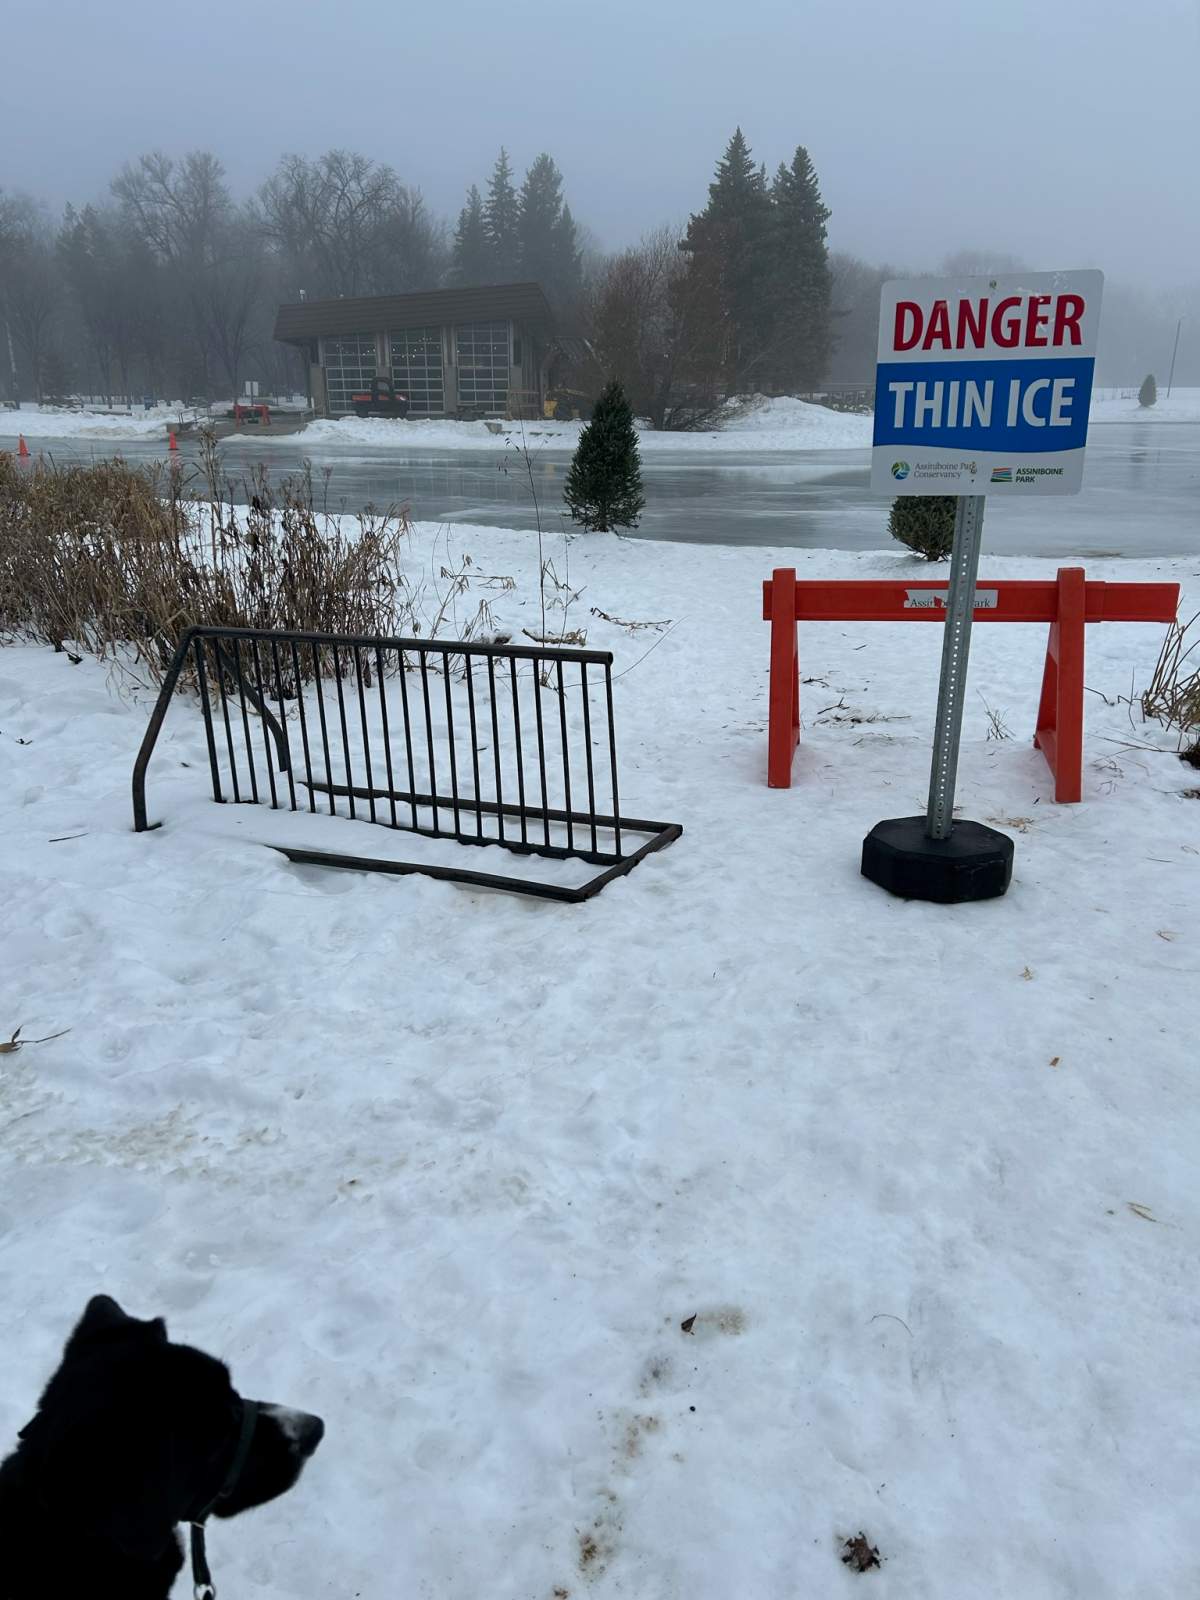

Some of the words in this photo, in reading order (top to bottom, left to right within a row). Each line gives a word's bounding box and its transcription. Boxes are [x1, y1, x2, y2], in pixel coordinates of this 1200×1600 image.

[893, 294, 1085, 351] DANGER
[888, 380, 994, 428] THIN
[1006, 377, 1075, 427] ICE
[914, 461, 959, 471] Assiniboine
[1016, 467, 1064, 475] ASSINIBOINE
[913, 471, 961, 480] Conservancy
[1015, 475, 1035, 483] PARK
[973, 598, 991, 608] ark
